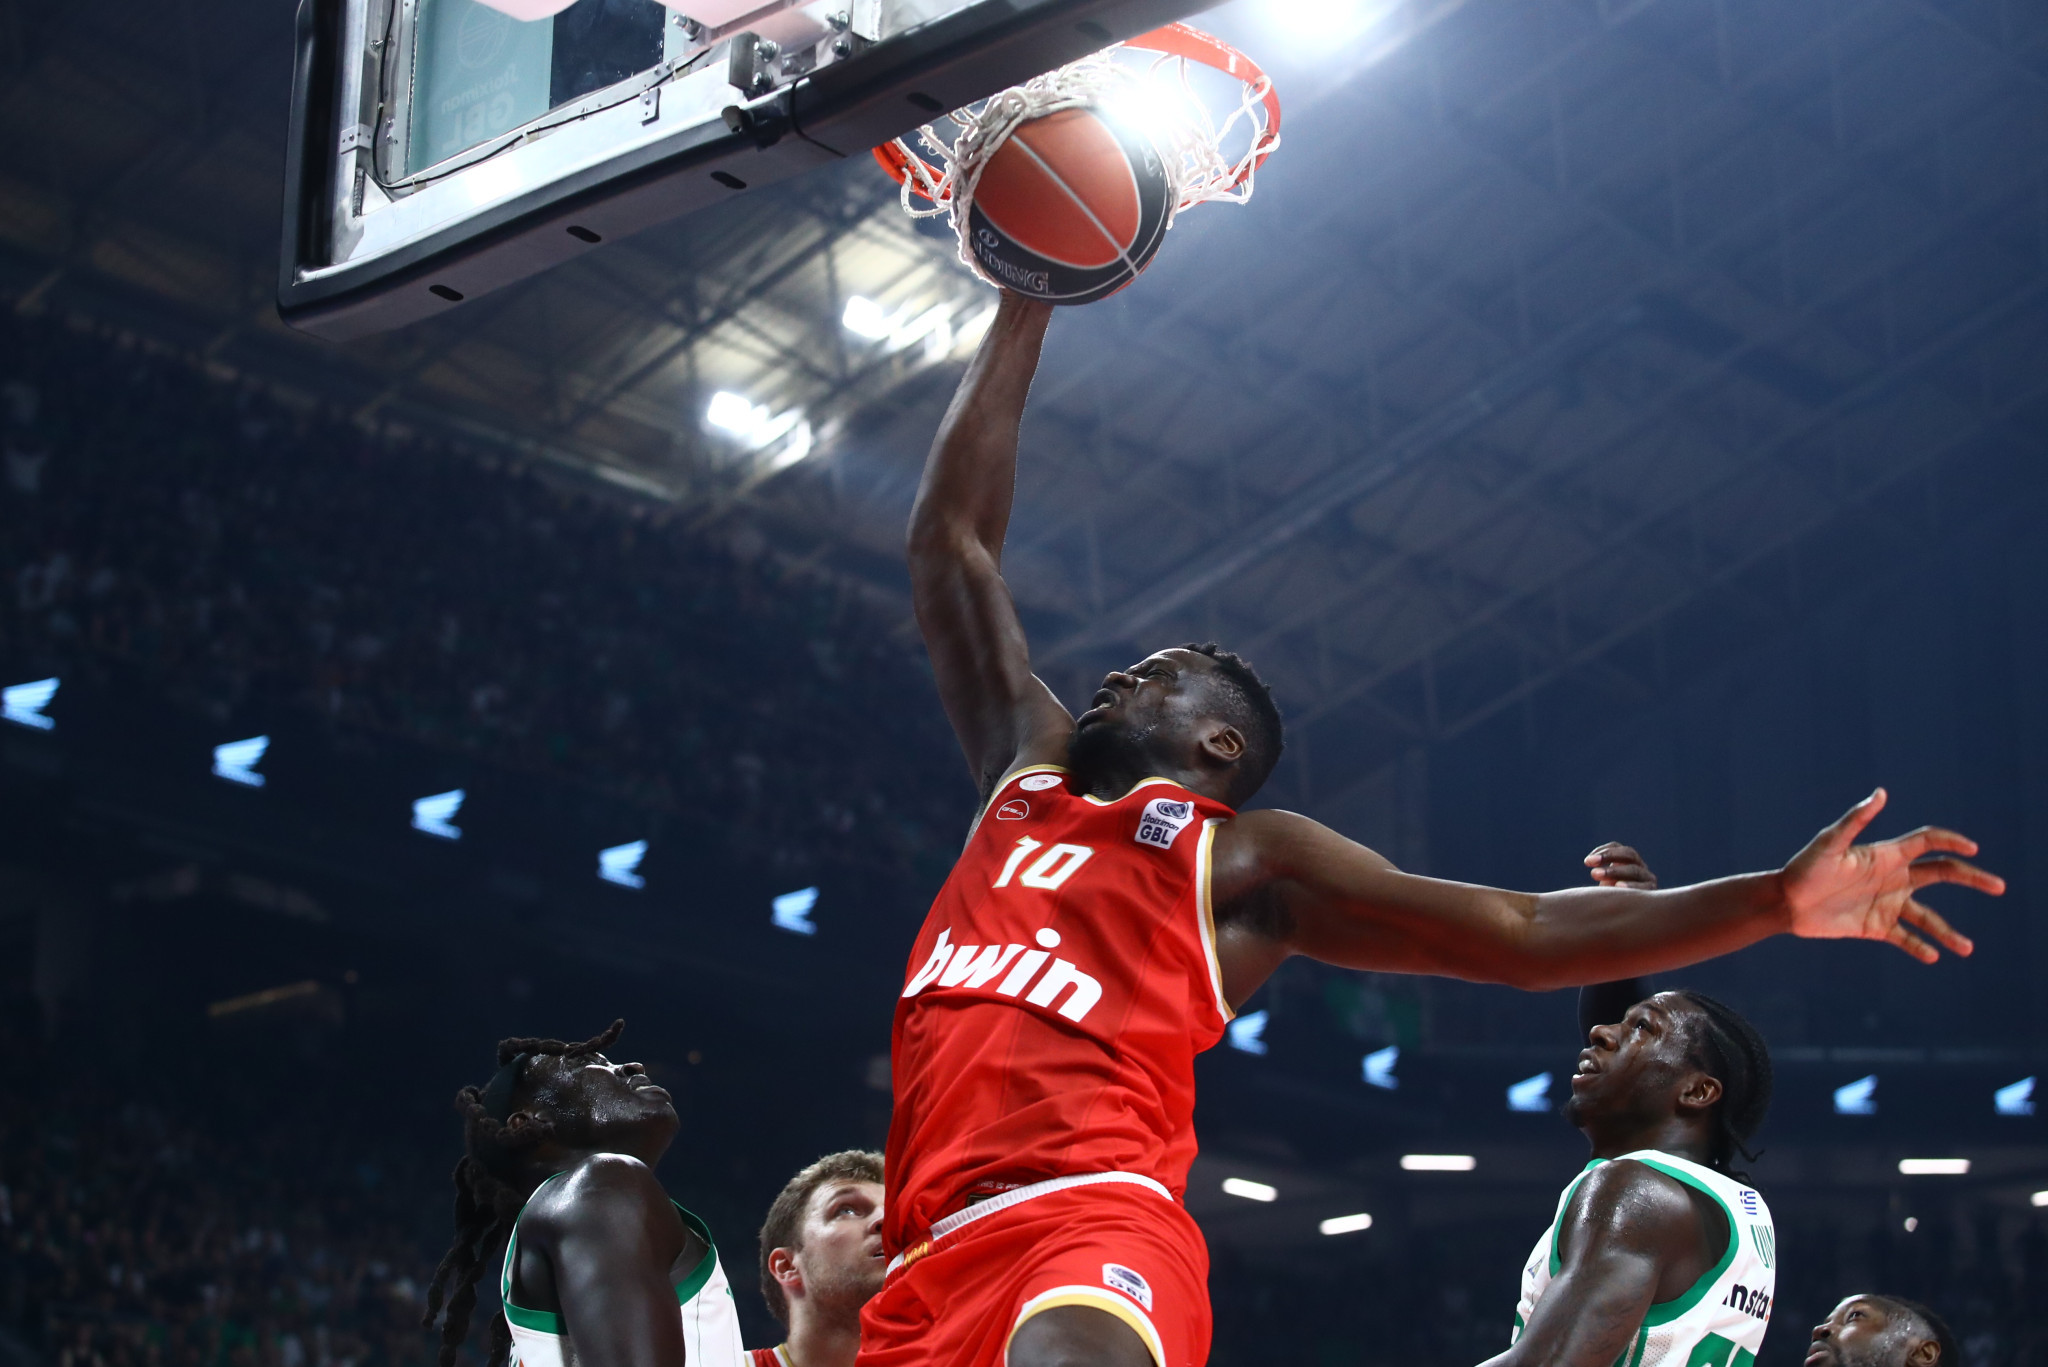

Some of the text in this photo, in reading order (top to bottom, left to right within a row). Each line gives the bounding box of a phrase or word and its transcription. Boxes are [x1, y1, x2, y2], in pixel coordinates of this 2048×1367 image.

[1140, 824, 1169, 846] GBL
[1143, 813, 1180, 831] Stoiximan
[992, 835, 1095, 891] 10
[902, 926, 1103, 1023] bwin
